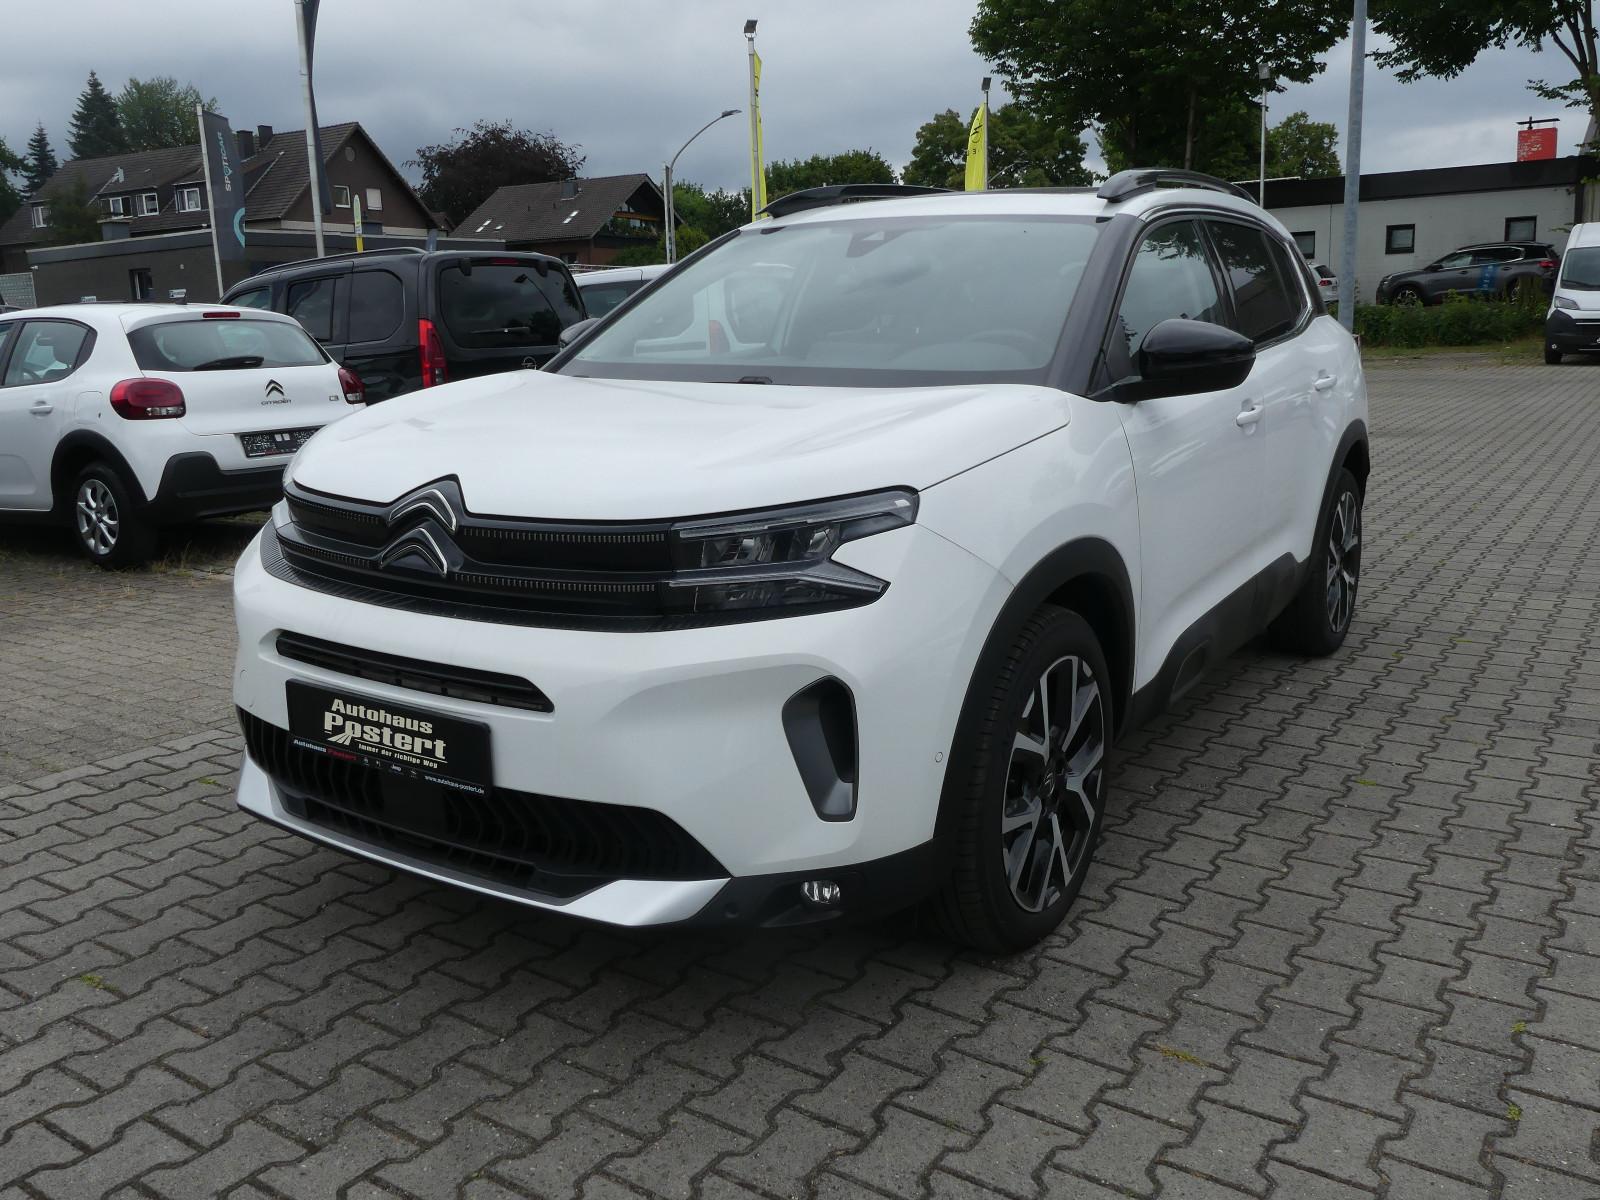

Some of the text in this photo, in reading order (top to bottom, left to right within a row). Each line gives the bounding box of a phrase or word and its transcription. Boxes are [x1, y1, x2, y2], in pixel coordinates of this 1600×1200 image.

[331, 698, 433, 734] Autohaus
[324, 711, 446, 760] Postert
[381, 749, 392, 758] der
[394, 752, 421, 764] richtige
[423, 760, 438, 769] Weg
